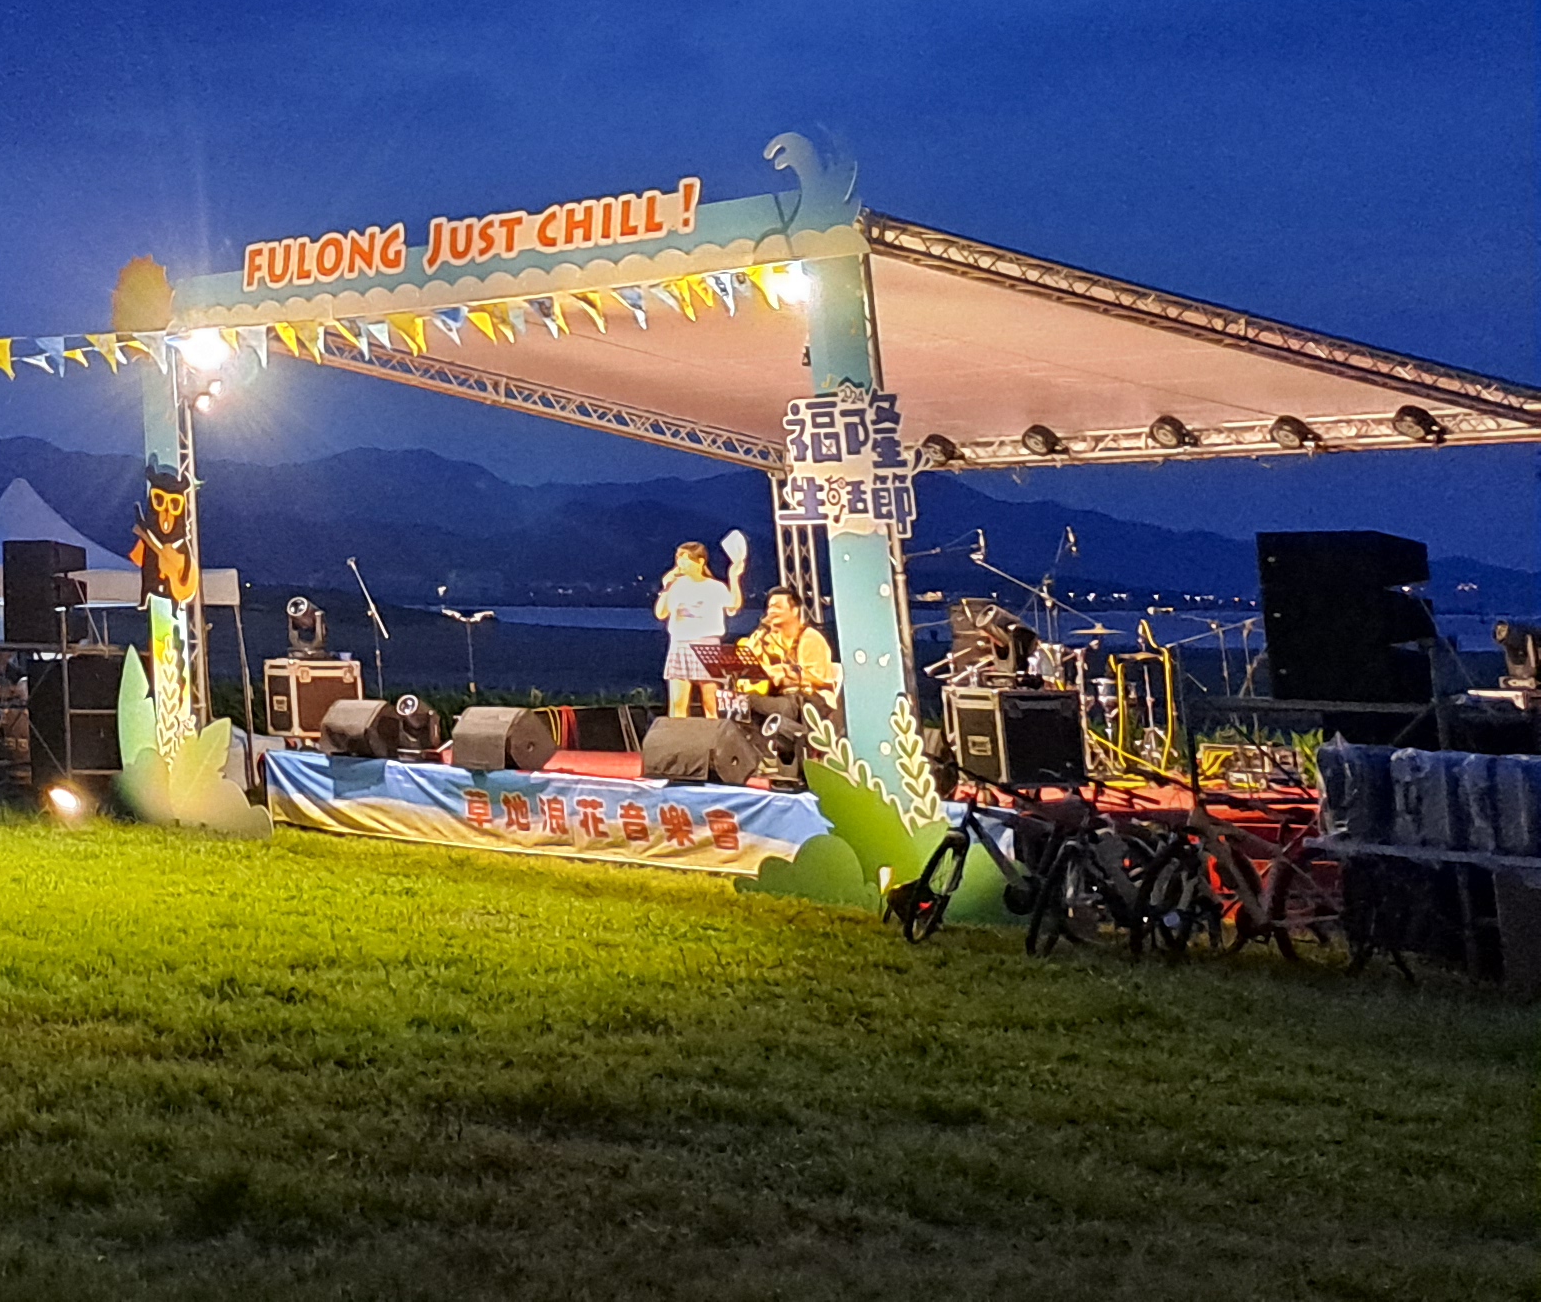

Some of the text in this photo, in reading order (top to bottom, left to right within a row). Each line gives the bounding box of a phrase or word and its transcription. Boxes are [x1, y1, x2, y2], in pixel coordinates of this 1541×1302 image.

[245, 226, 404, 289] FULONG
[425, 215, 524, 269] JUST
[785, 388, 908, 469] 福隆
[778, 472, 913, 535] 生活節
[463, 789, 739, 850] 草地浪花音樂會
